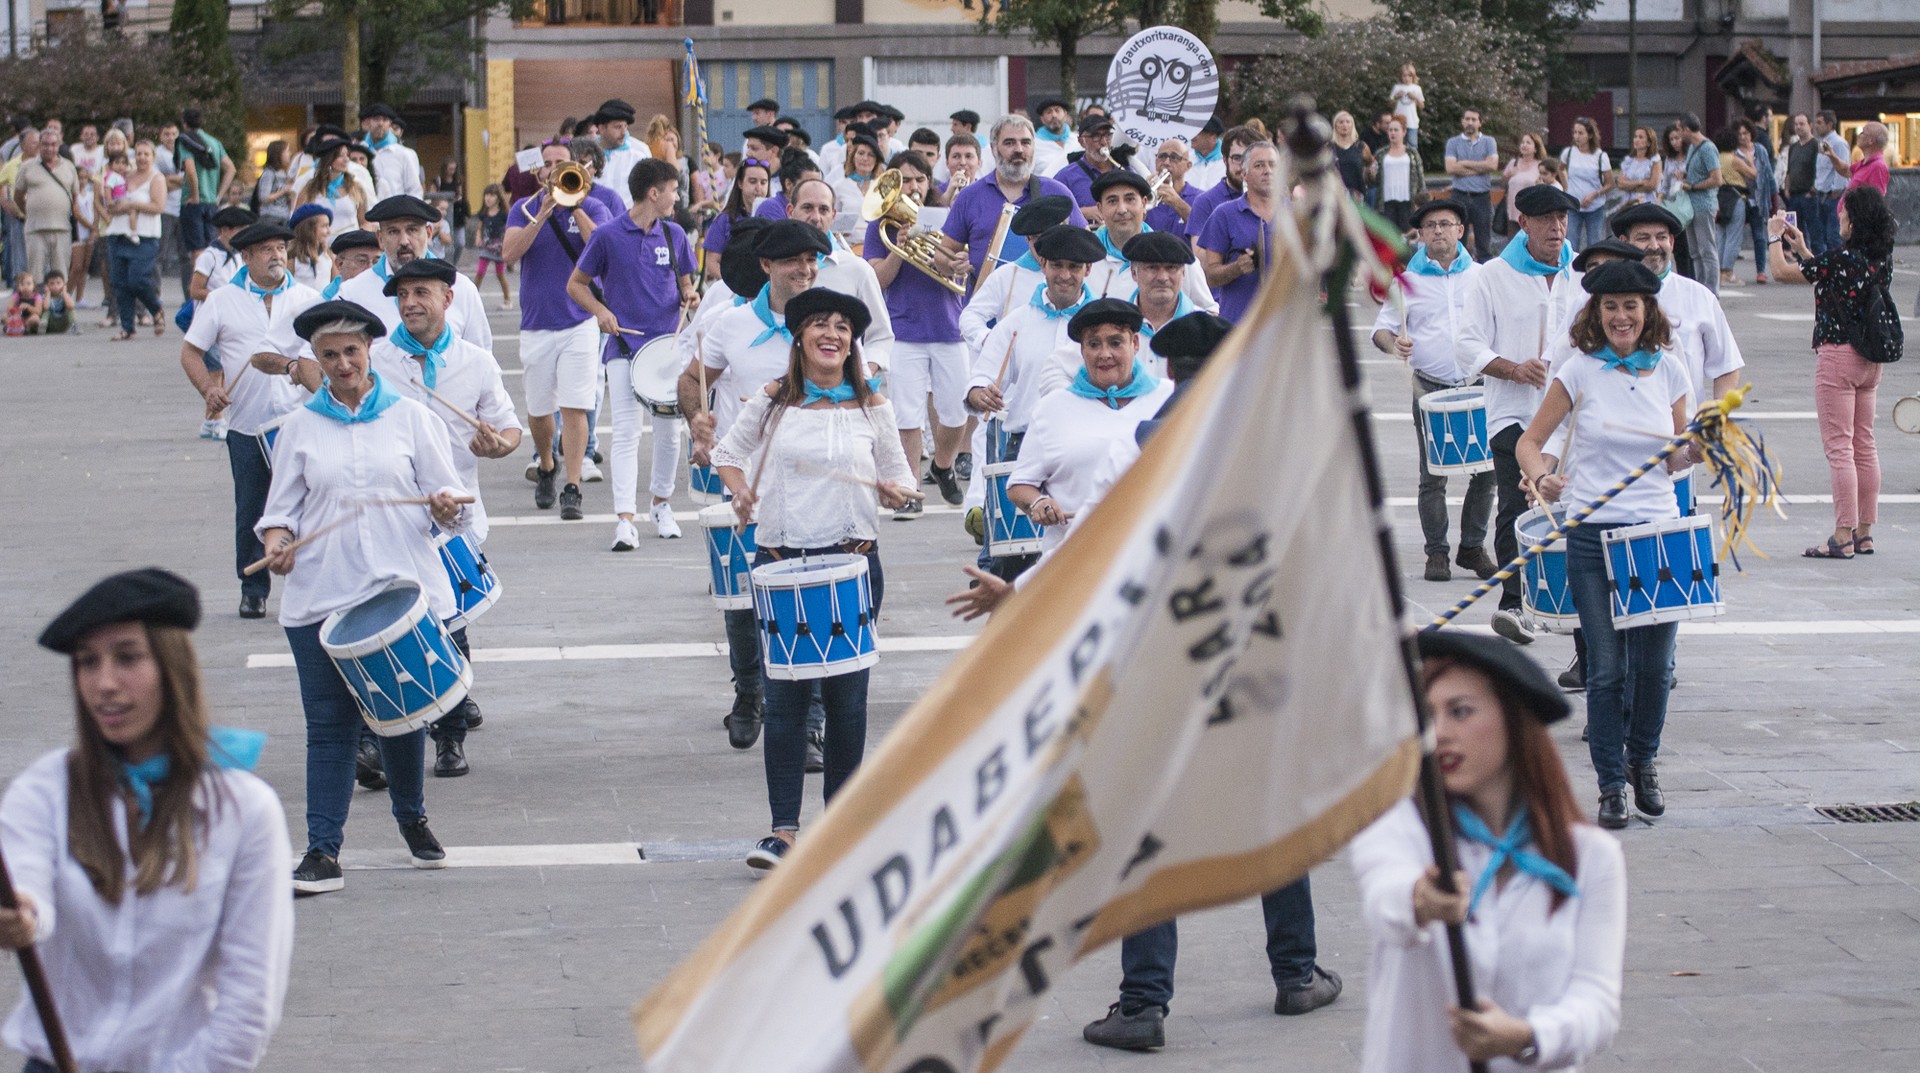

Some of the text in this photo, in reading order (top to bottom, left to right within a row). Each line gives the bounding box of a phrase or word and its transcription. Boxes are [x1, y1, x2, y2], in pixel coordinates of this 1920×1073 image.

[1121, 30, 1212, 78] gautxoritxaranga.com
[1124, 127, 1146, 143] 664
[1144, 136, 1158, 148] 39
